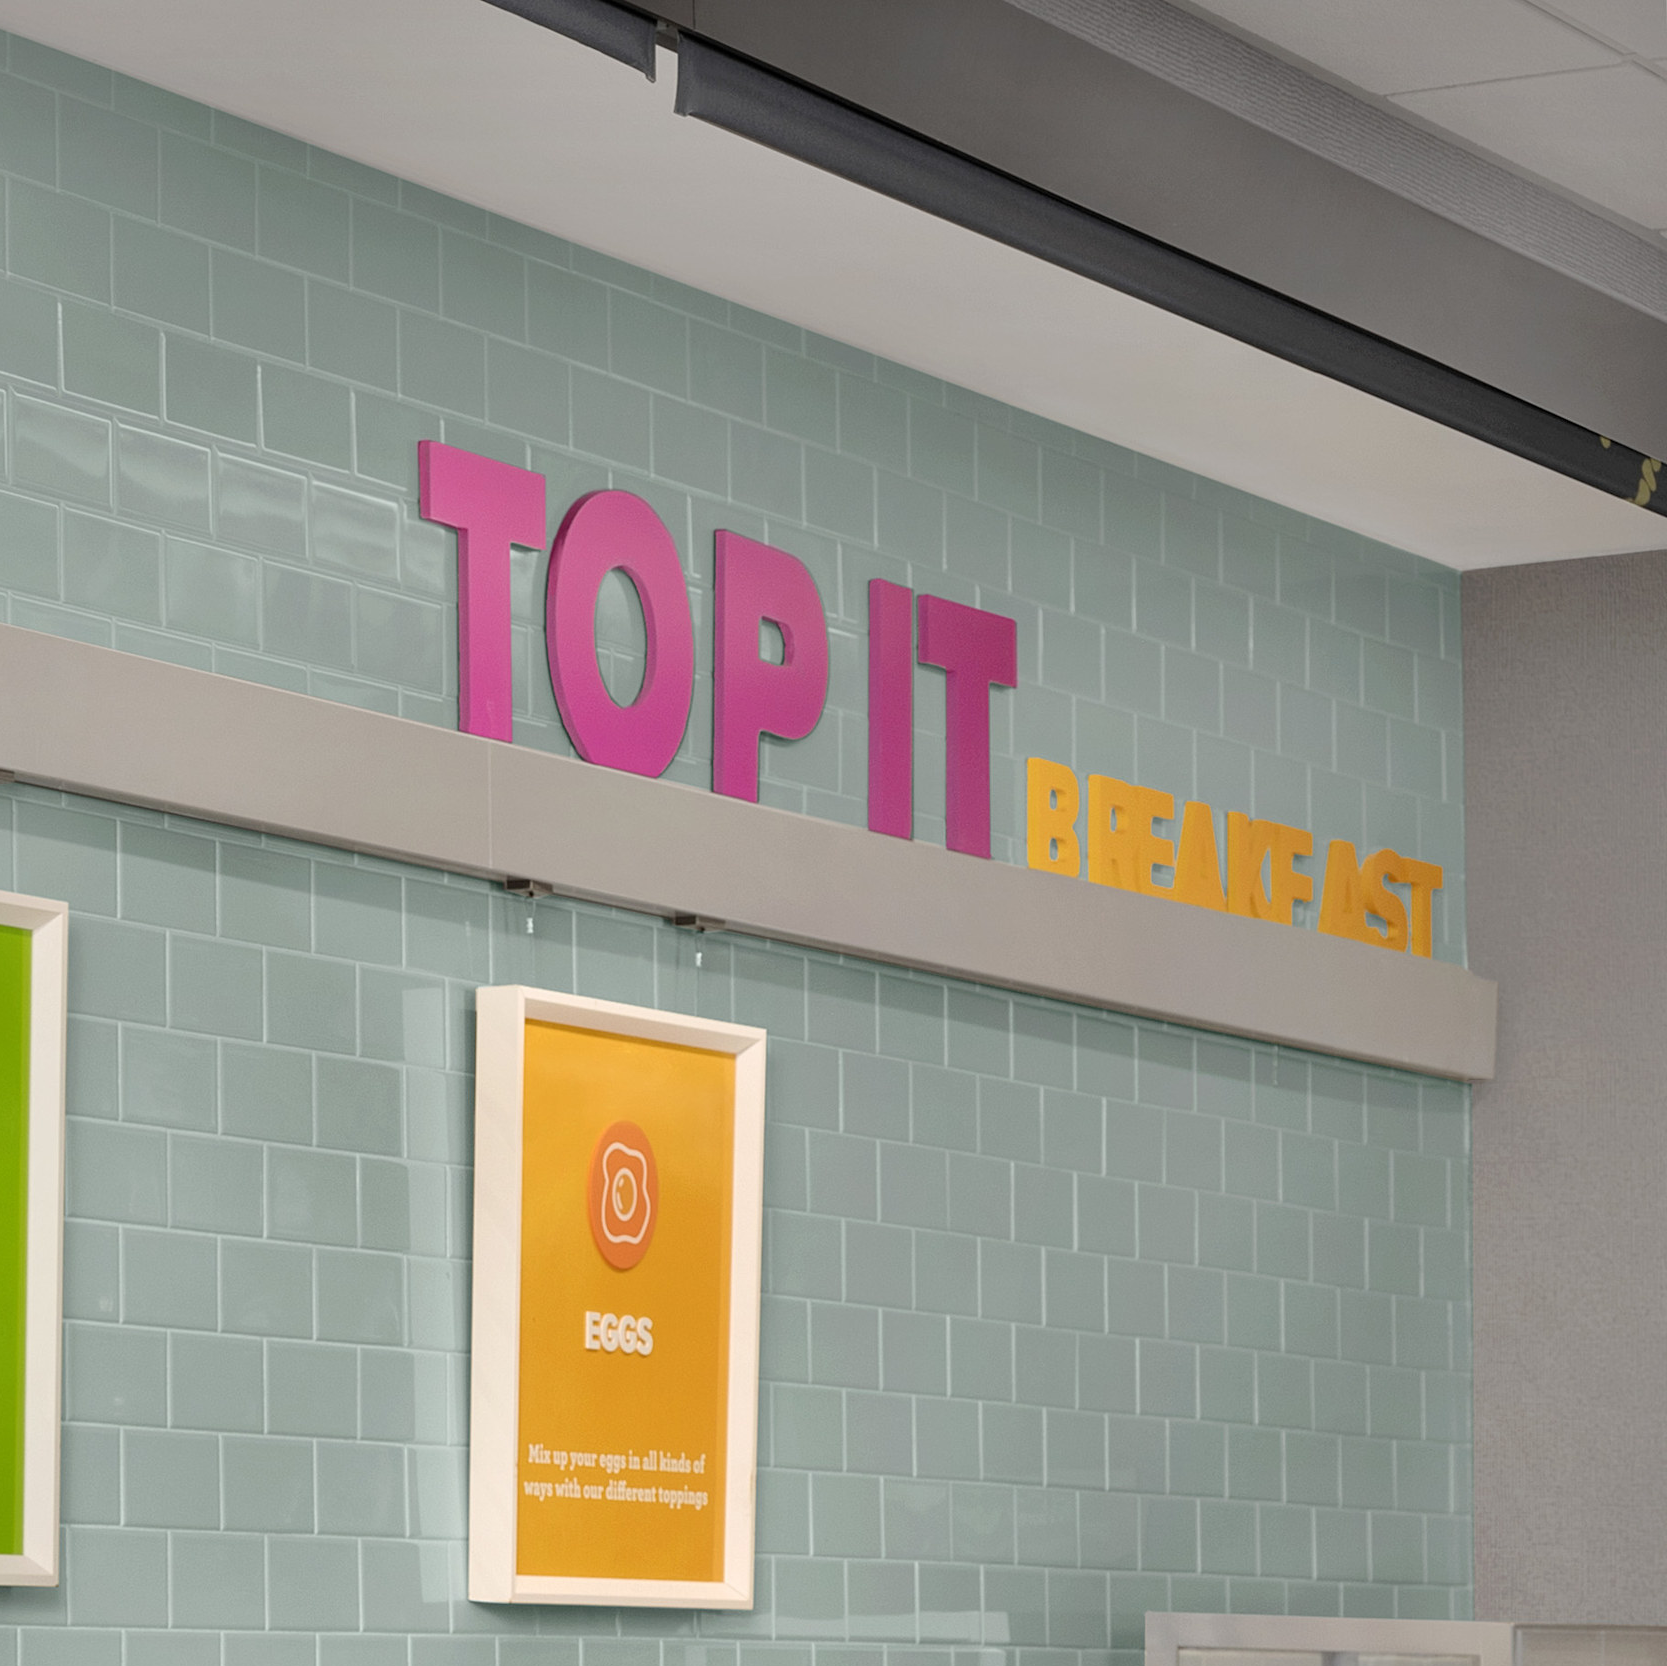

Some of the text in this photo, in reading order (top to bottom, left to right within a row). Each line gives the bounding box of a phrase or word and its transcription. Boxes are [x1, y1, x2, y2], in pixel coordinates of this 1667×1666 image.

[418, 439, 1018, 860] TOP IT
[1026, 756, 1444, 960] BREAKFAST
[585, 1310, 653, 1356] EGGS
[528, 1443, 706, 1474] Mix up your eggs in all kinds of
[524, 1477, 708, 1510] ways with our different toppings
